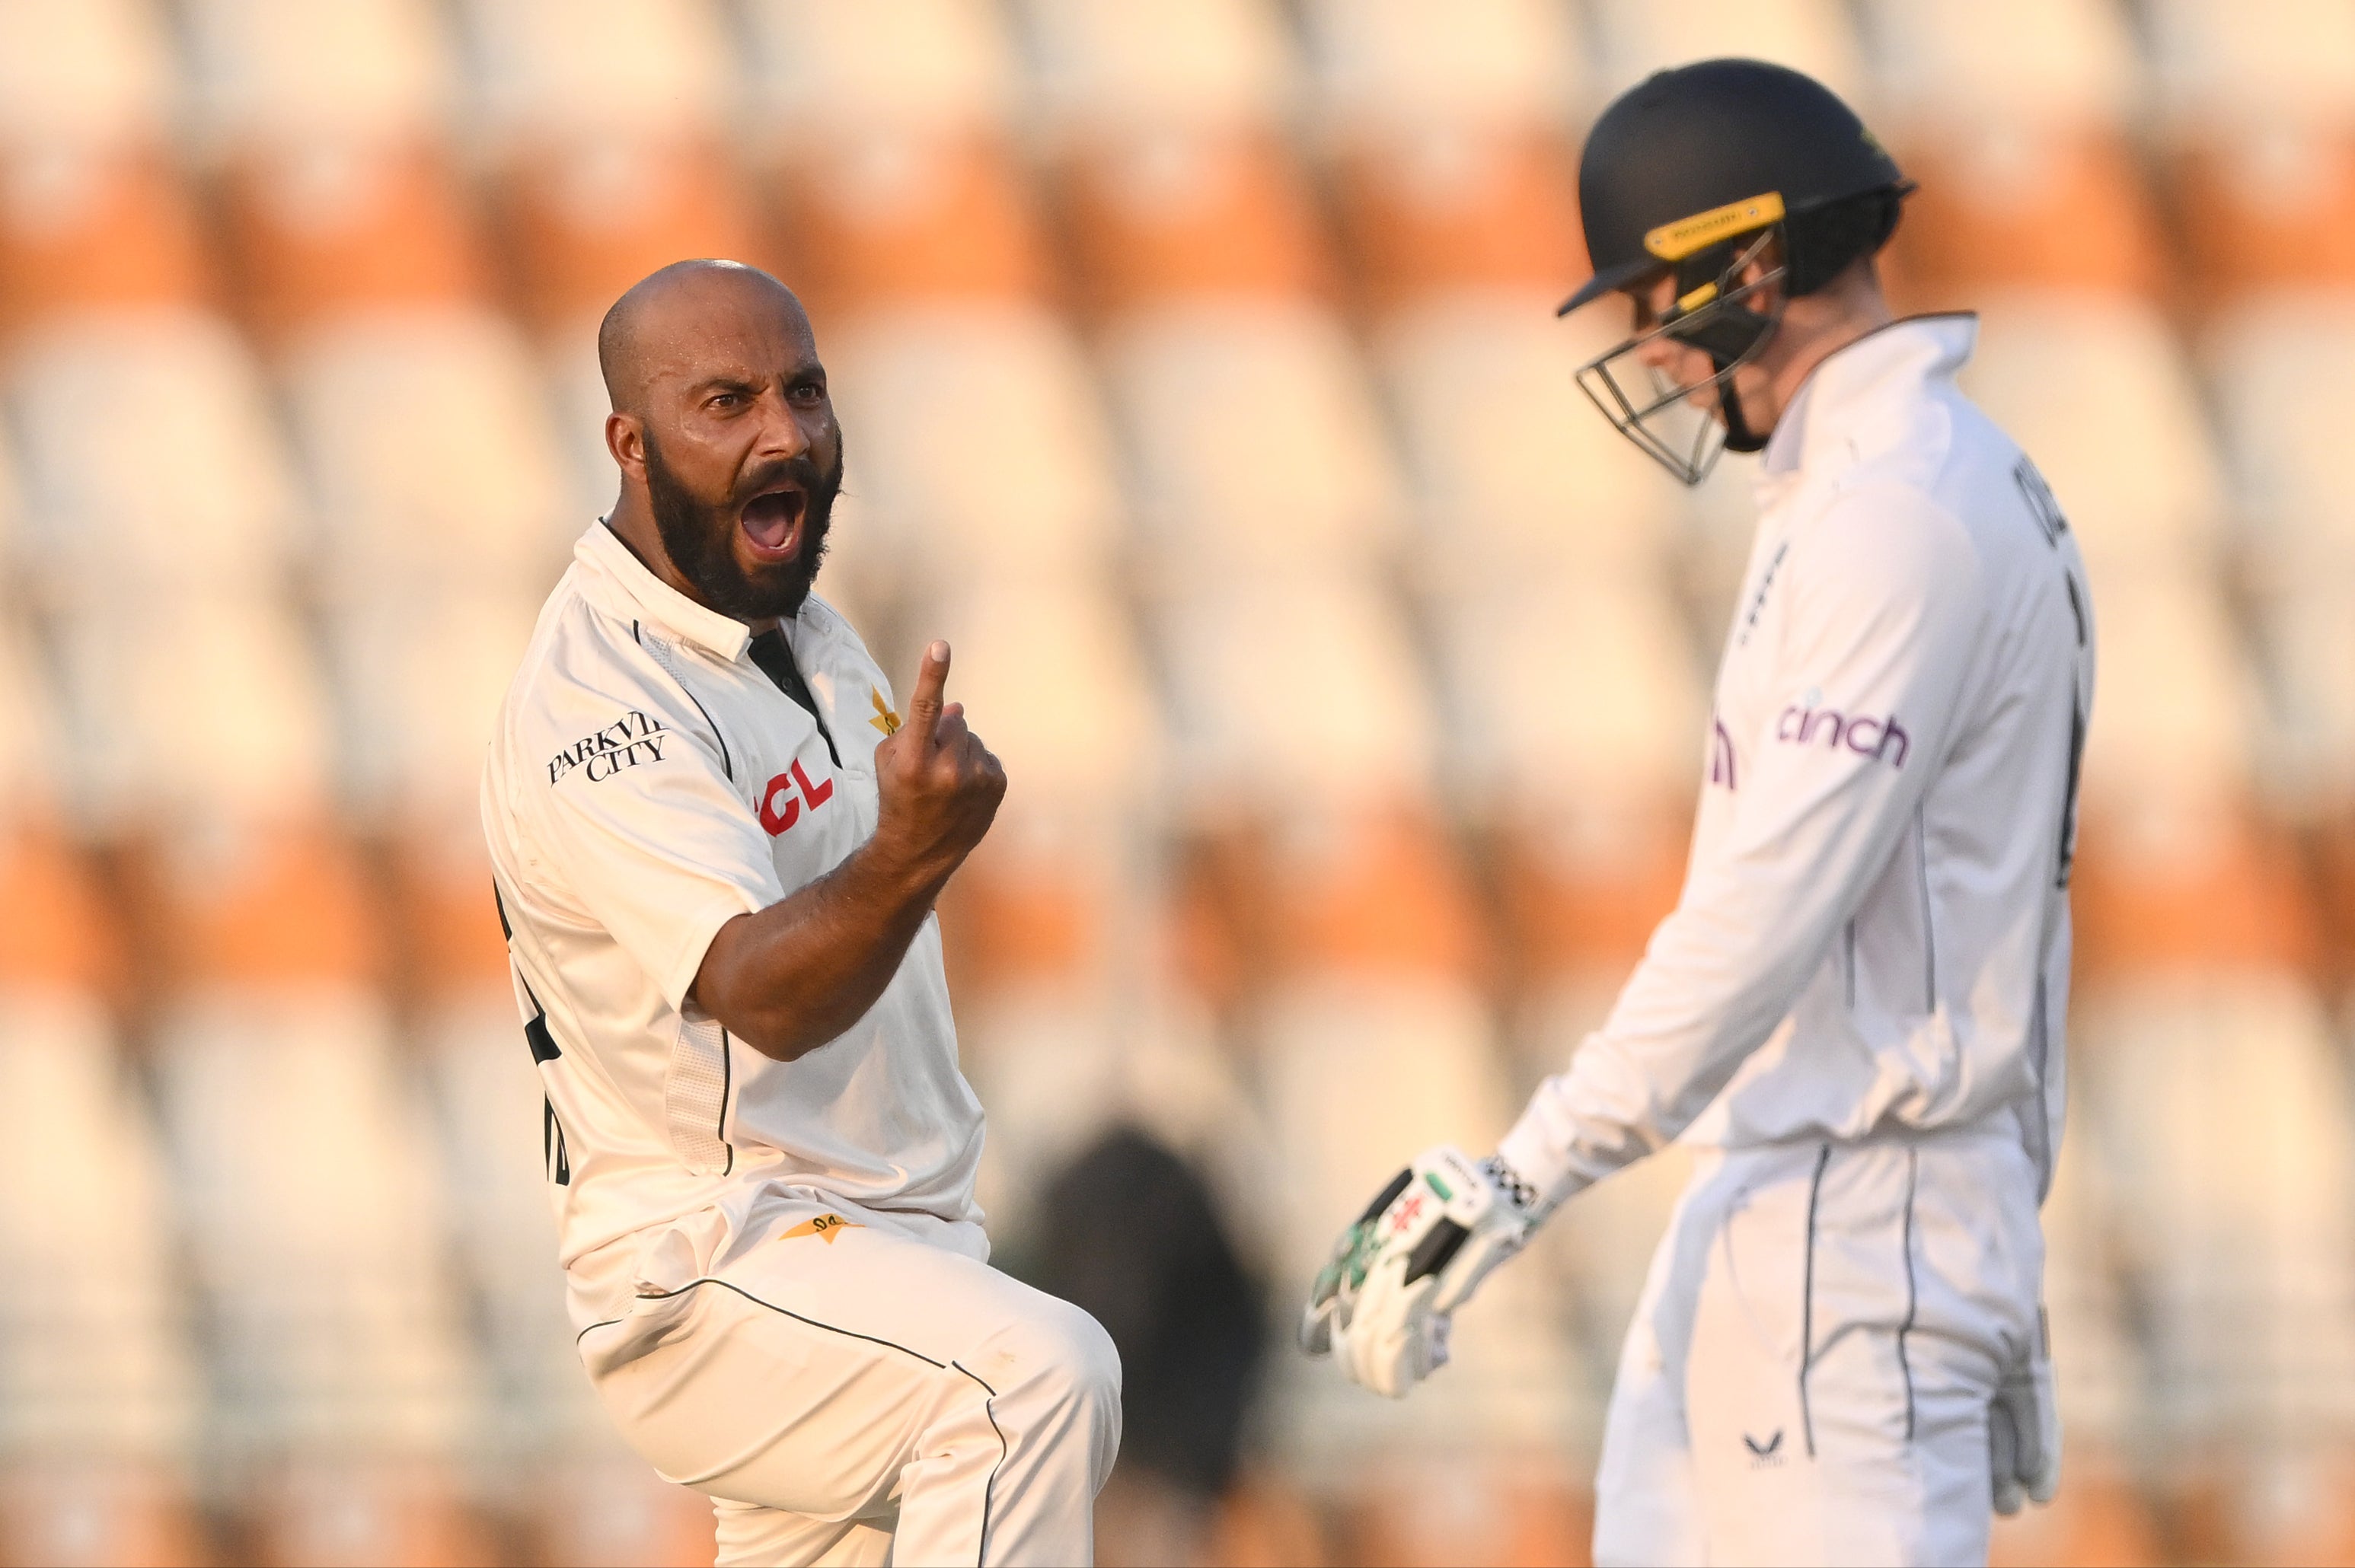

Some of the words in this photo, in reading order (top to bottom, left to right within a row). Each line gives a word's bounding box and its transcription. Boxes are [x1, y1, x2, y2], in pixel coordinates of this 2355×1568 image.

[586, 735, 666, 782] CITY
[1778, 687, 1910, 767] cinch
[753, 756, 834, 838] CL
